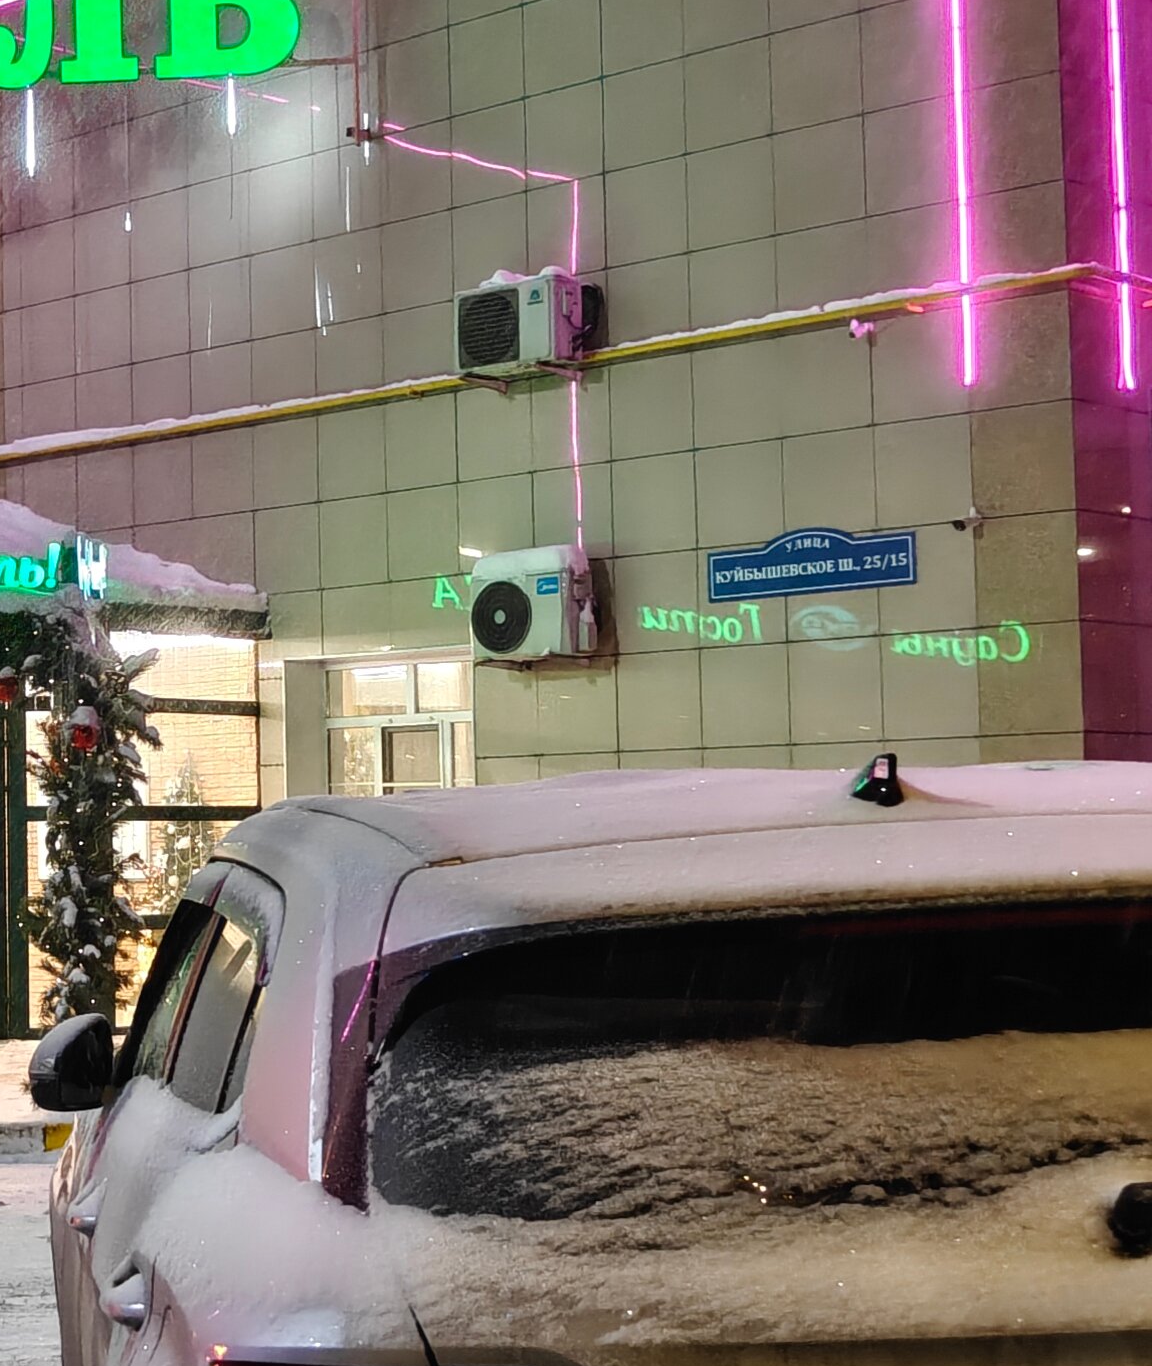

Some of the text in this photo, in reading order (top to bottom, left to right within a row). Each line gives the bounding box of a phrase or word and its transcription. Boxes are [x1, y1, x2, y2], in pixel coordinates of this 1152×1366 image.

[785, 537, 831, 552] УЛИЦА
[715, 560, 835, 584] КУЙБЫШЕВСКОЕ
[863, 552, 908, 571] 25/15
